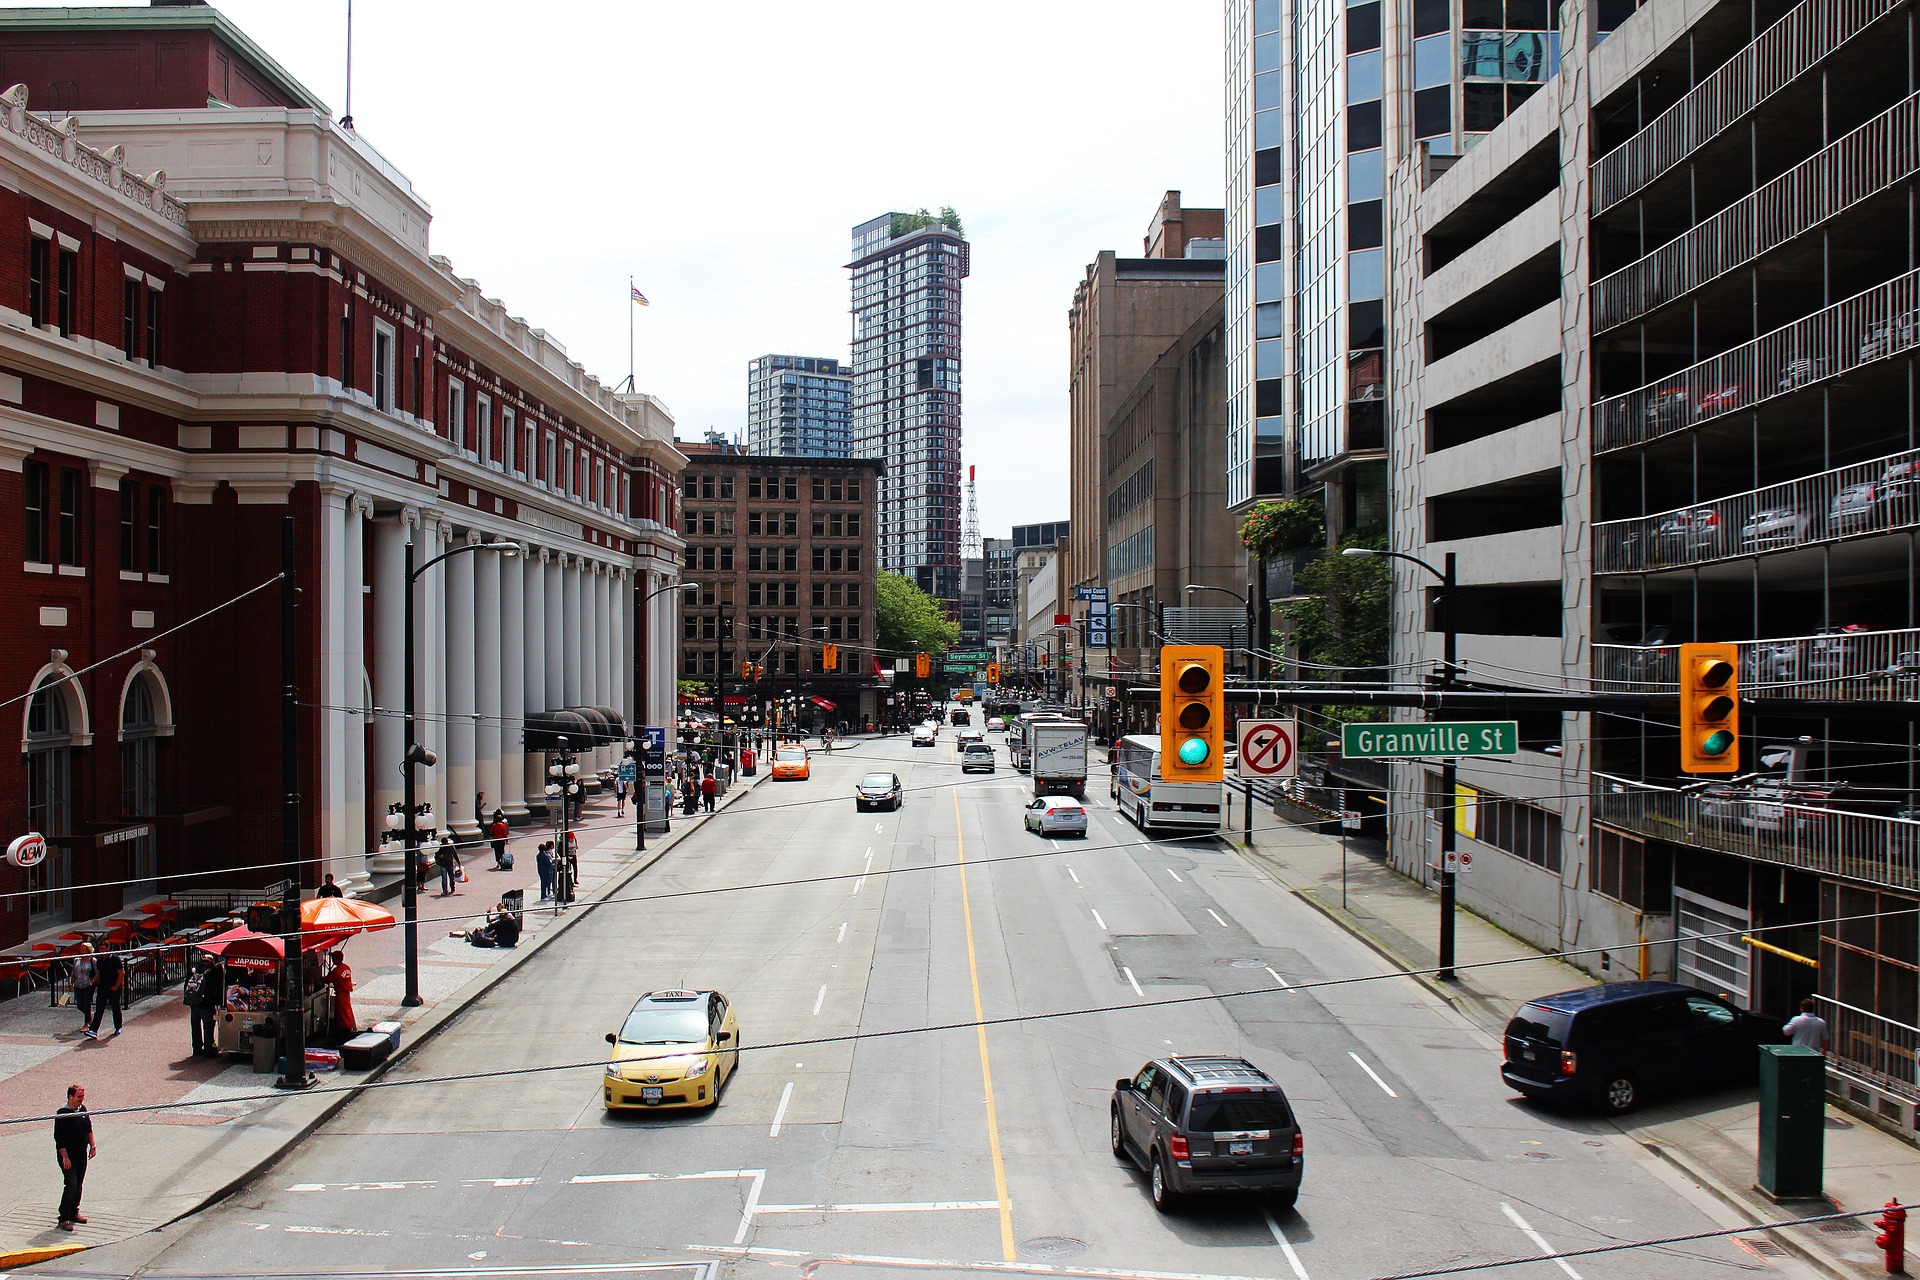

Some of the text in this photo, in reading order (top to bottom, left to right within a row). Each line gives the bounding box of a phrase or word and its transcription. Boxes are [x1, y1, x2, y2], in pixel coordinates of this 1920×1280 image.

[649, 731, 660, 744] T
[1358, 727, 1503, 753] Granville St
[104, 833, 114, 845] HOME
[114, 832, 119, 843] OF
[20, 845, 44, 862] A&W
[234, 957, 270, 967] JAPADOG
